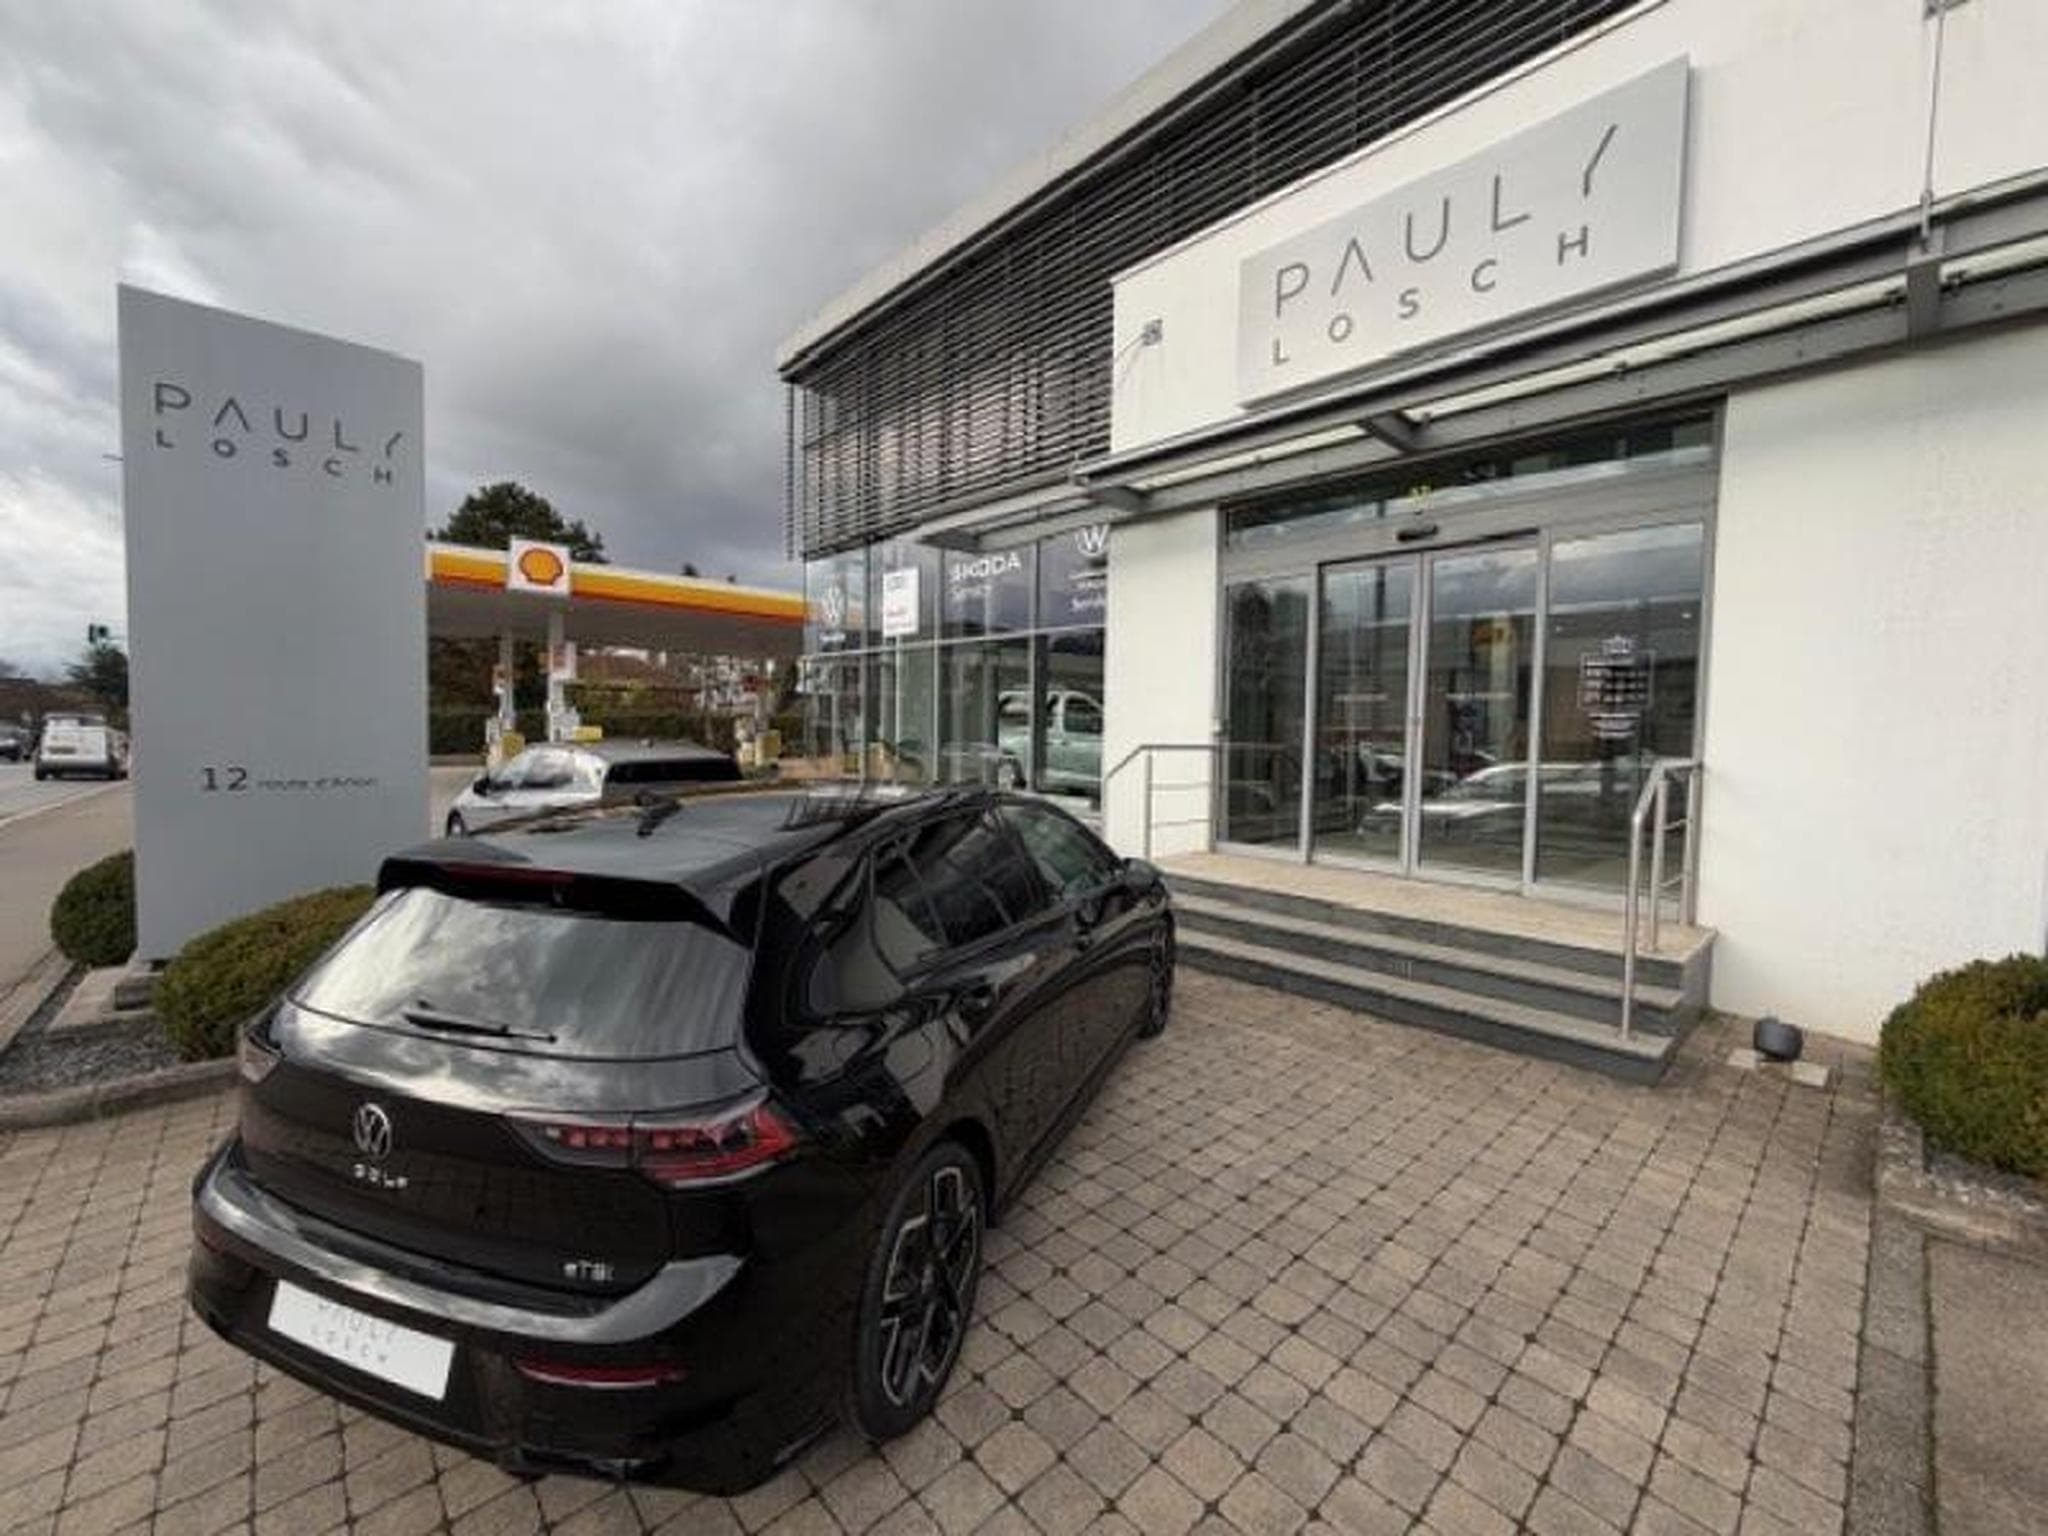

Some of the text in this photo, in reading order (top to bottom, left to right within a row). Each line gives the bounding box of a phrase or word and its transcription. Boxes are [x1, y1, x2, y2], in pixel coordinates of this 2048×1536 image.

[1275, 122, 1619, 319] PAULY
[1273, 224, 1589, 367] LOSCH
[154, 381, 403, 457] PAULY
[155, 428, 392, 486] LOSCH
[202, 767, 248, 792] 12
